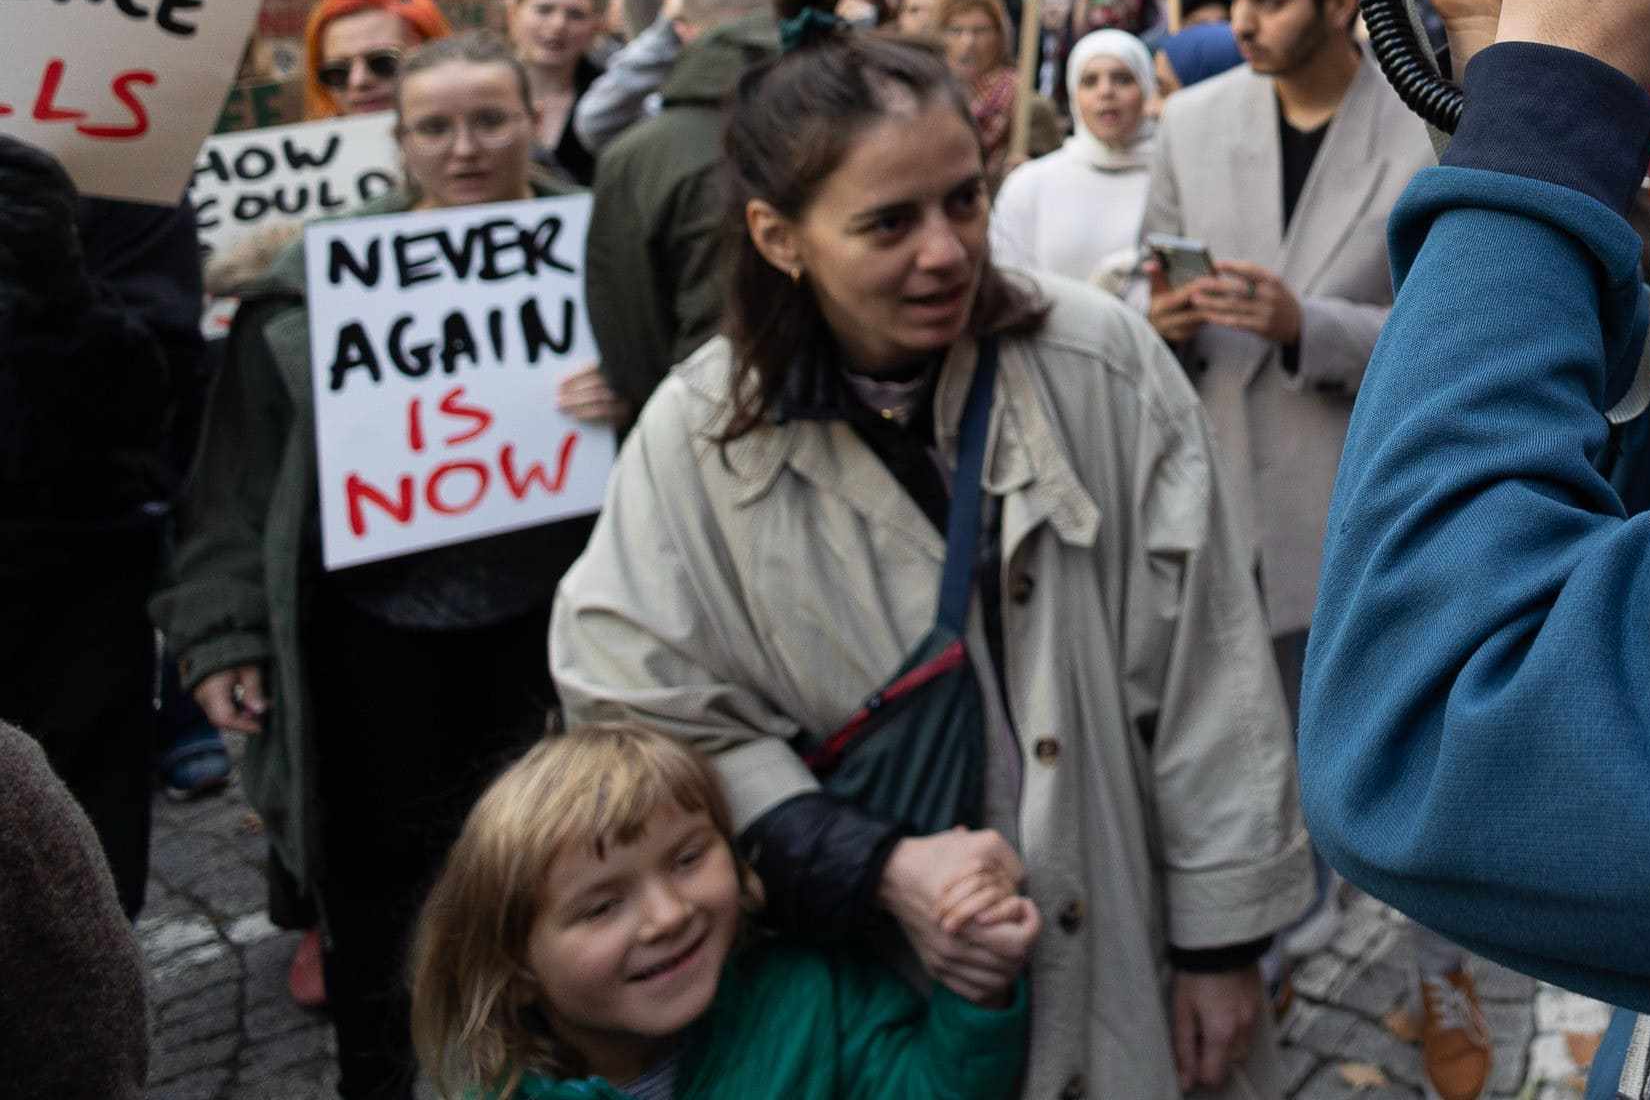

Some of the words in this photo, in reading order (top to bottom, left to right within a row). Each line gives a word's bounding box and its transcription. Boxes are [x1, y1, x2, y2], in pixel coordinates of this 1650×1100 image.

[0, 58, 157, 140] LS
[327, 216, 576, 288] NEVER
[329, 294, 576, 392] AGAIN
[408, 386, 494, 453] IS
[345, 429, 580, 538] NOW
